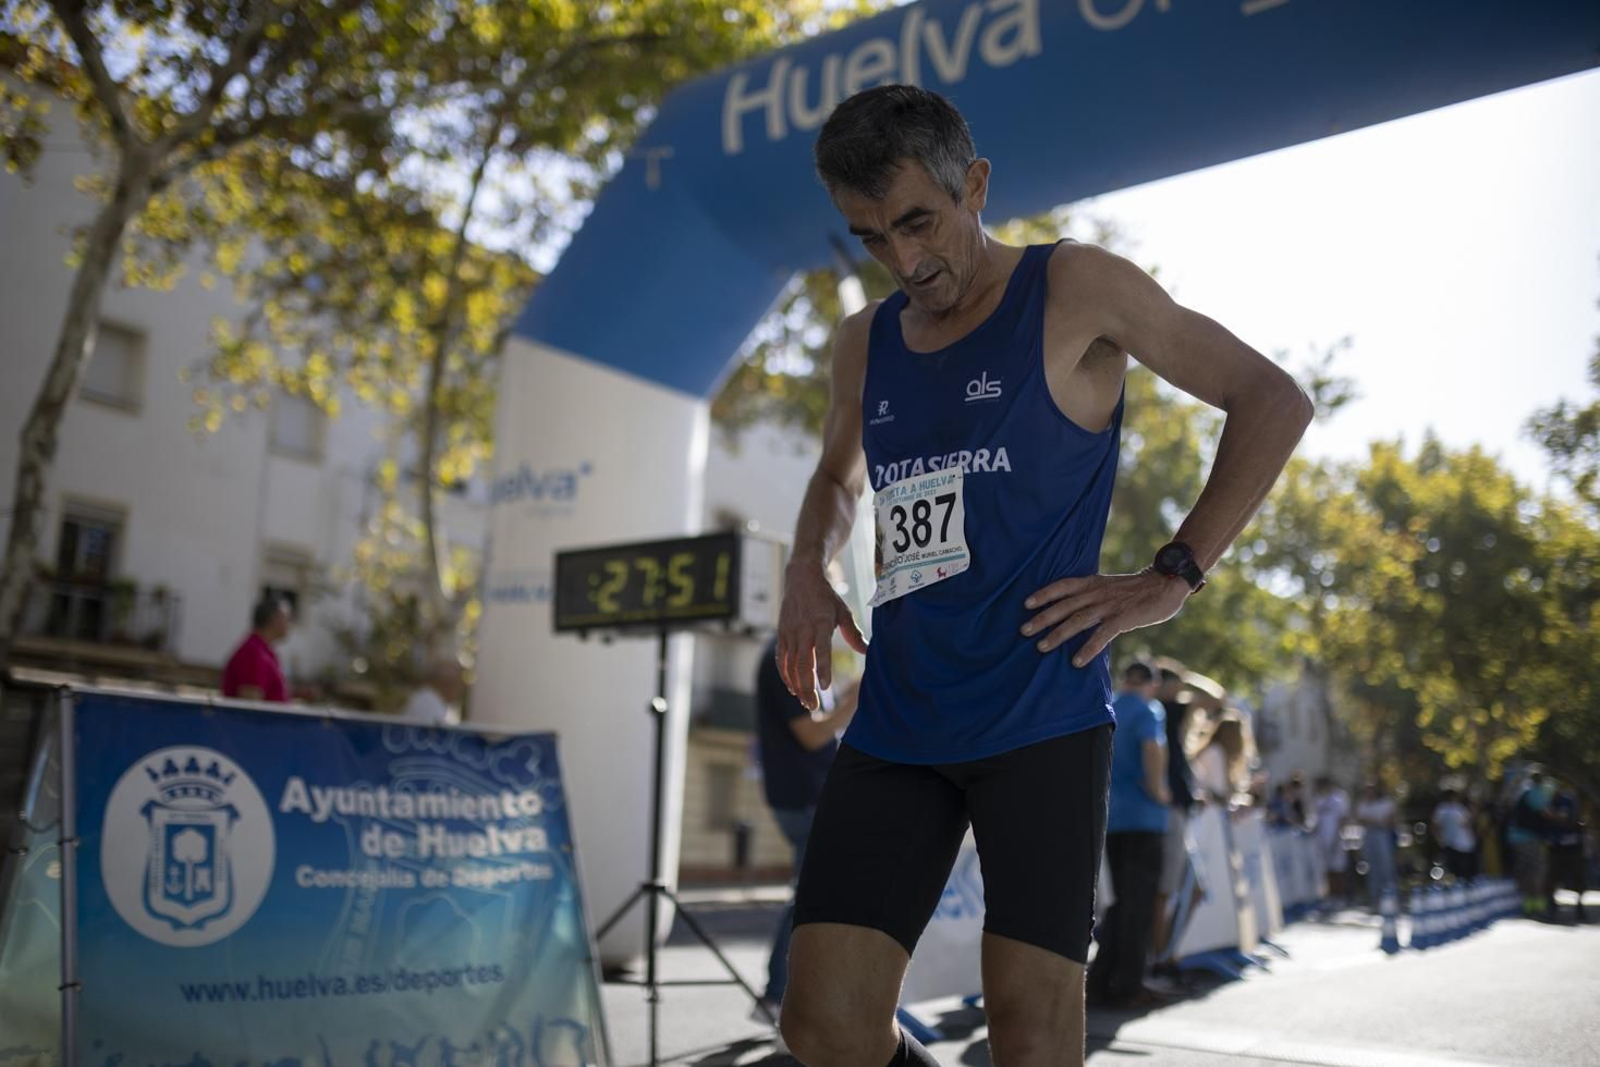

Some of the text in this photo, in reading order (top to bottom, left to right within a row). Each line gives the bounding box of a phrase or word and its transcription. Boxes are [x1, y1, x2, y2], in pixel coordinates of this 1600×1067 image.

[722, 0, 1043, 155] Huelva
[890, 492, 957, 554] 387
[279, 776, 543, 823] Ayuntamiento
[361, 824, 548, 857] de Huelva
[421, 868, 448, 887] de
[453, 862, 553, 889] Deportes
[179, 964, 504, 1002] www.huelva.es/deportes
